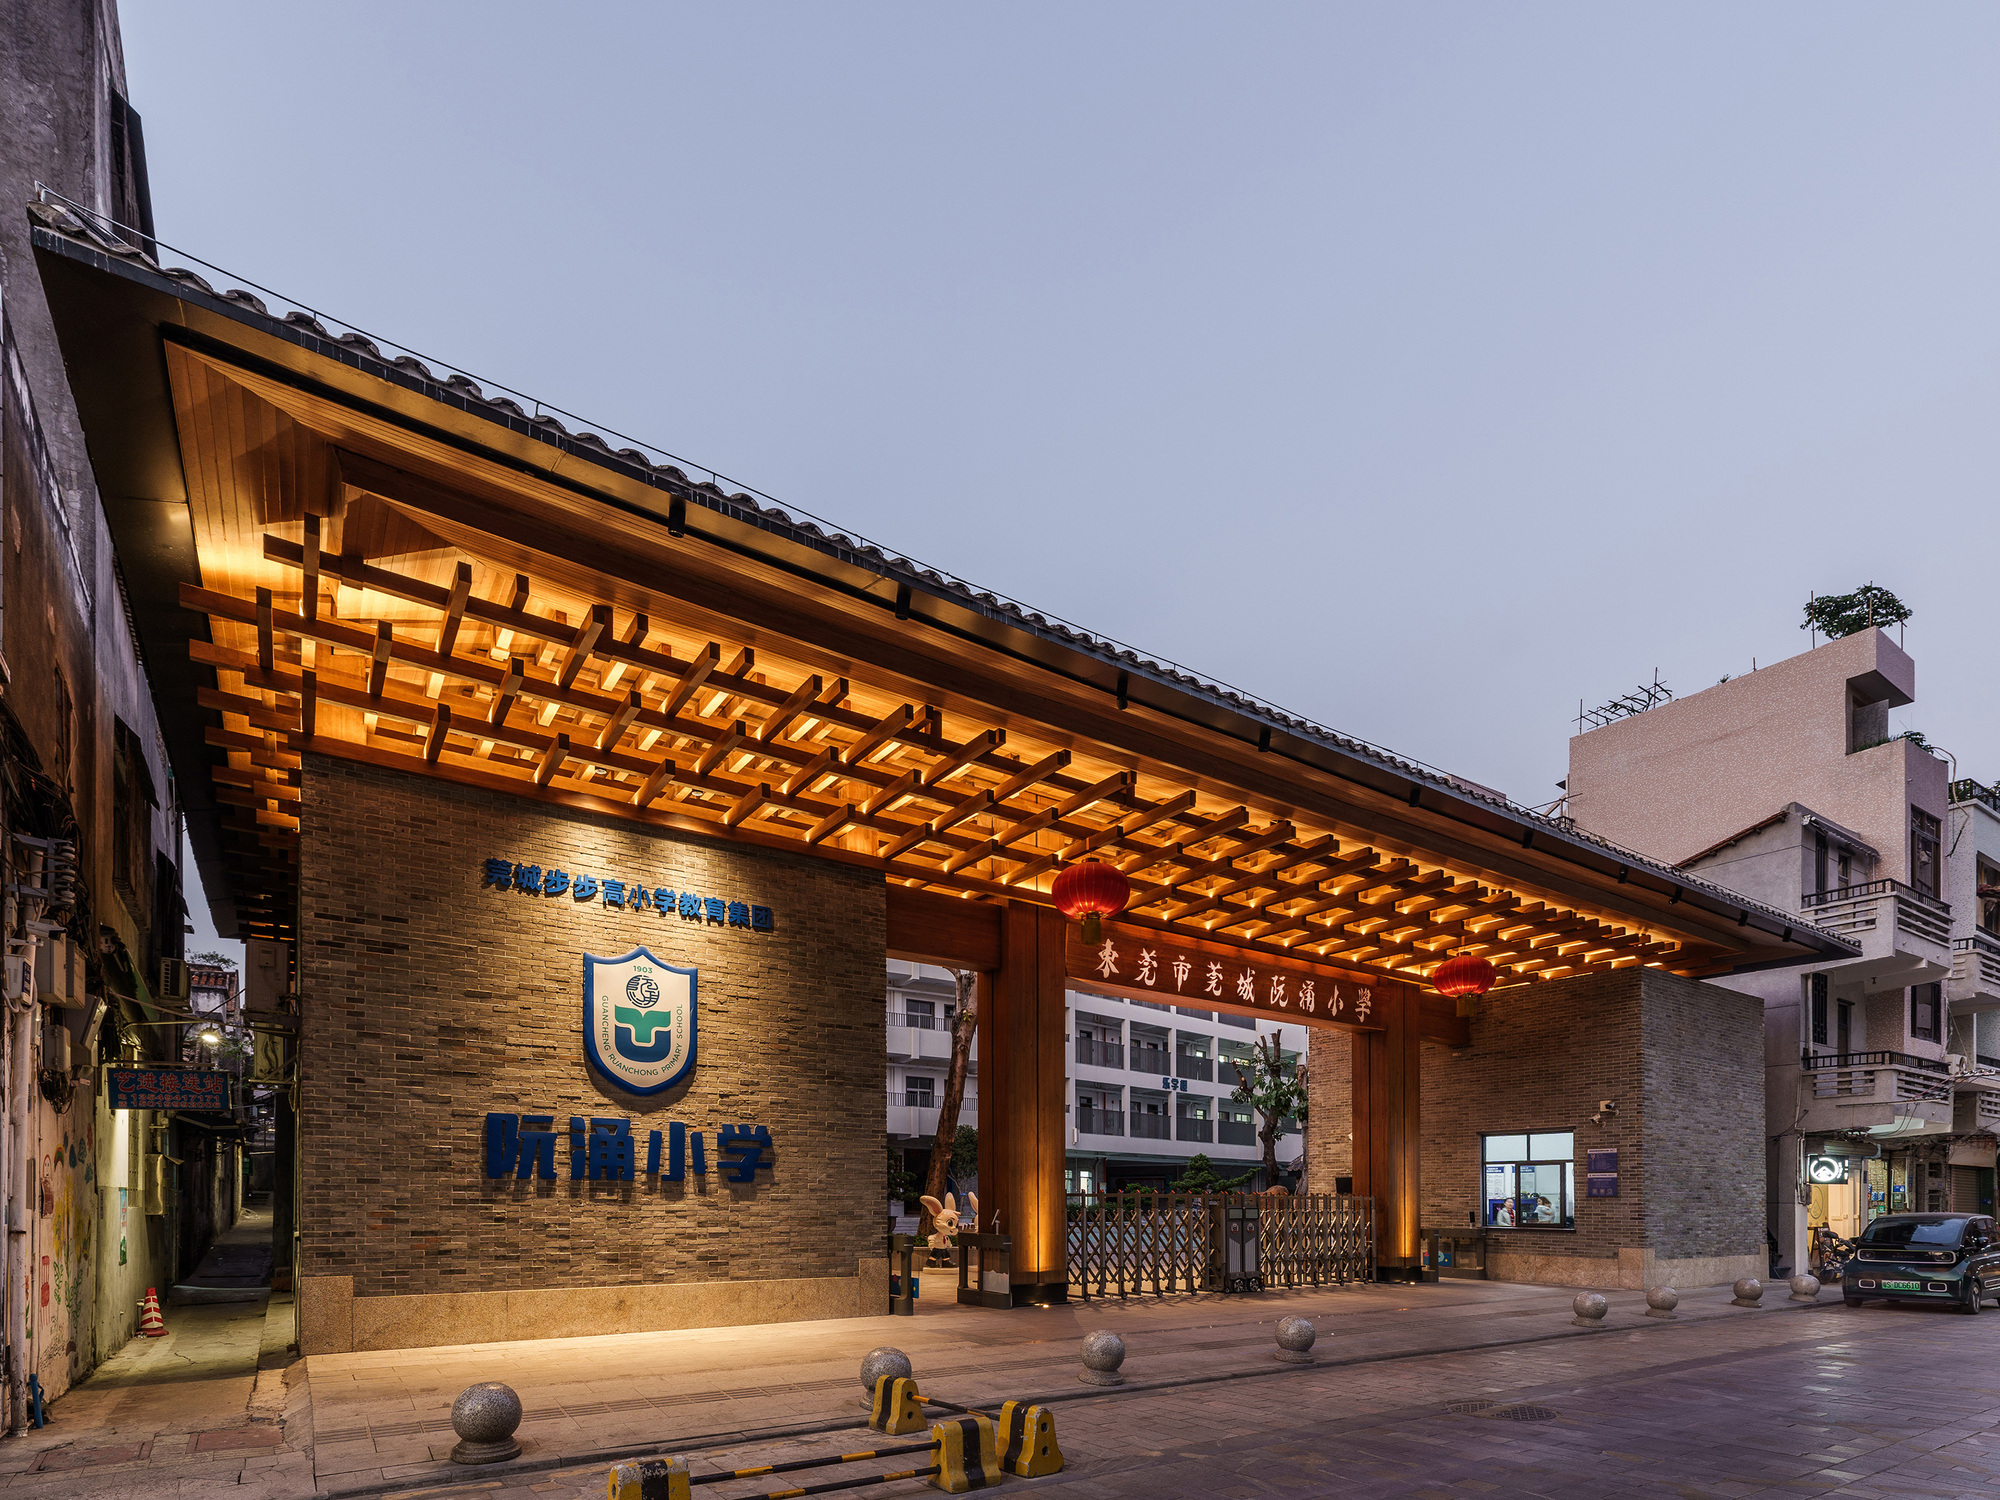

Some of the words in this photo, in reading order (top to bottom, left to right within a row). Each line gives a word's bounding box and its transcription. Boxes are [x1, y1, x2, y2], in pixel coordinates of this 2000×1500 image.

[486, 858, 772, 930] 莞城步步高小学教育集团
[633, 965, 653, 974] 1903
[601, 995, 611, 1051] GUANCHENG
[608, 1053, 659, 1076] RUANCHONG
[661, 1043, 683, 1073] PRIMARY
[113, 1071, 224, 1094] 艺进接送站
[487, 1112, 772, 1183] 阮涌小学
